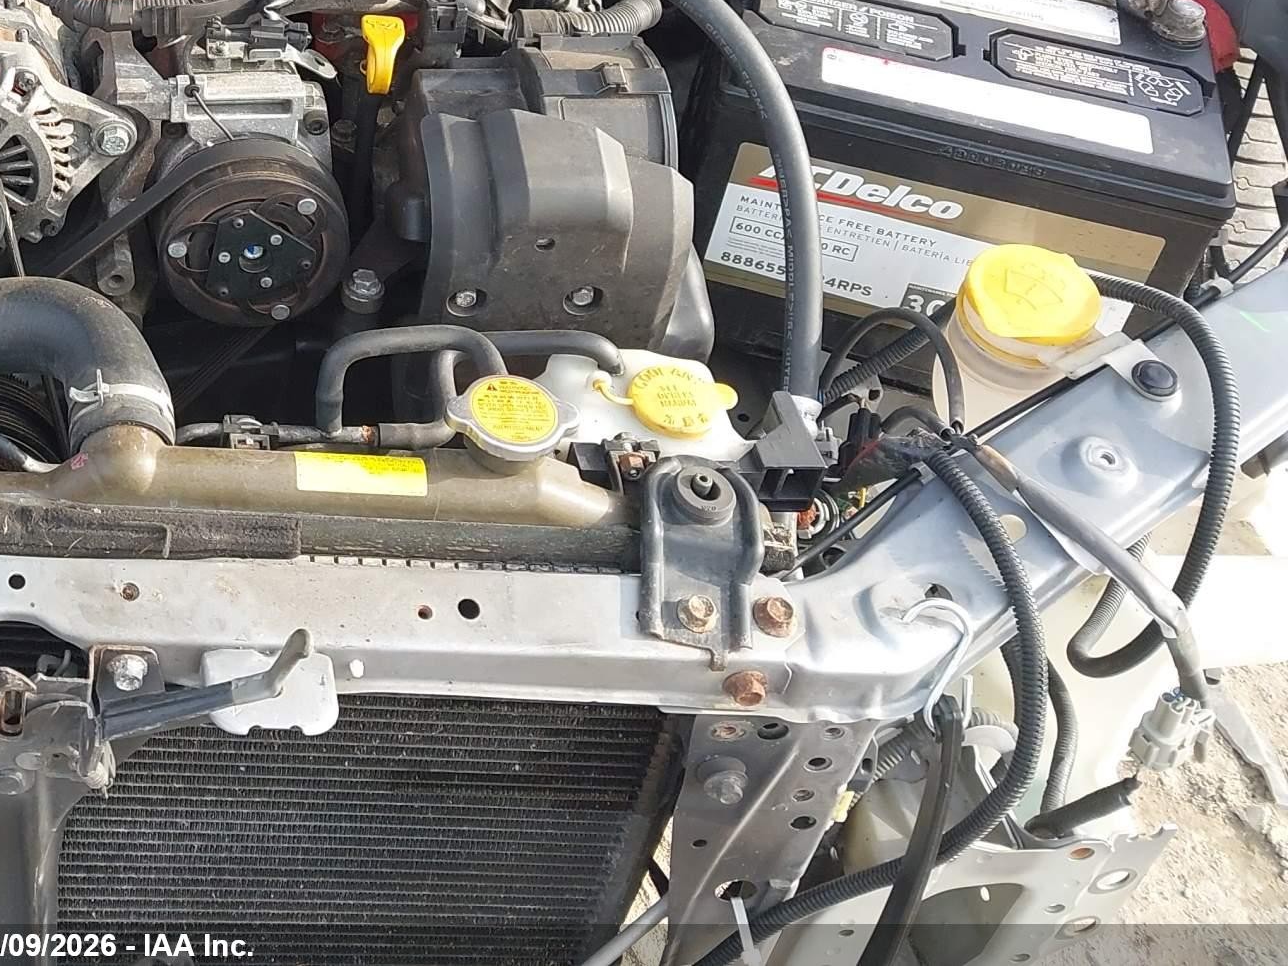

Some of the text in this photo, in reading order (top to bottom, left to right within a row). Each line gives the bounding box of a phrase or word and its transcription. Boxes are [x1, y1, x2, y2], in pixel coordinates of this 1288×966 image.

[869, 7, 915, 24] POISON
[734, 222, 761, 236] 600
[831, 244, 852, 257] RC
[826, 226, 891, 248] ENTRETIEN
[838, 217, 872, 233] FREE
[876, 226, 937, 248] BATTERY
[821, 275, 873, 297] 4RPS
